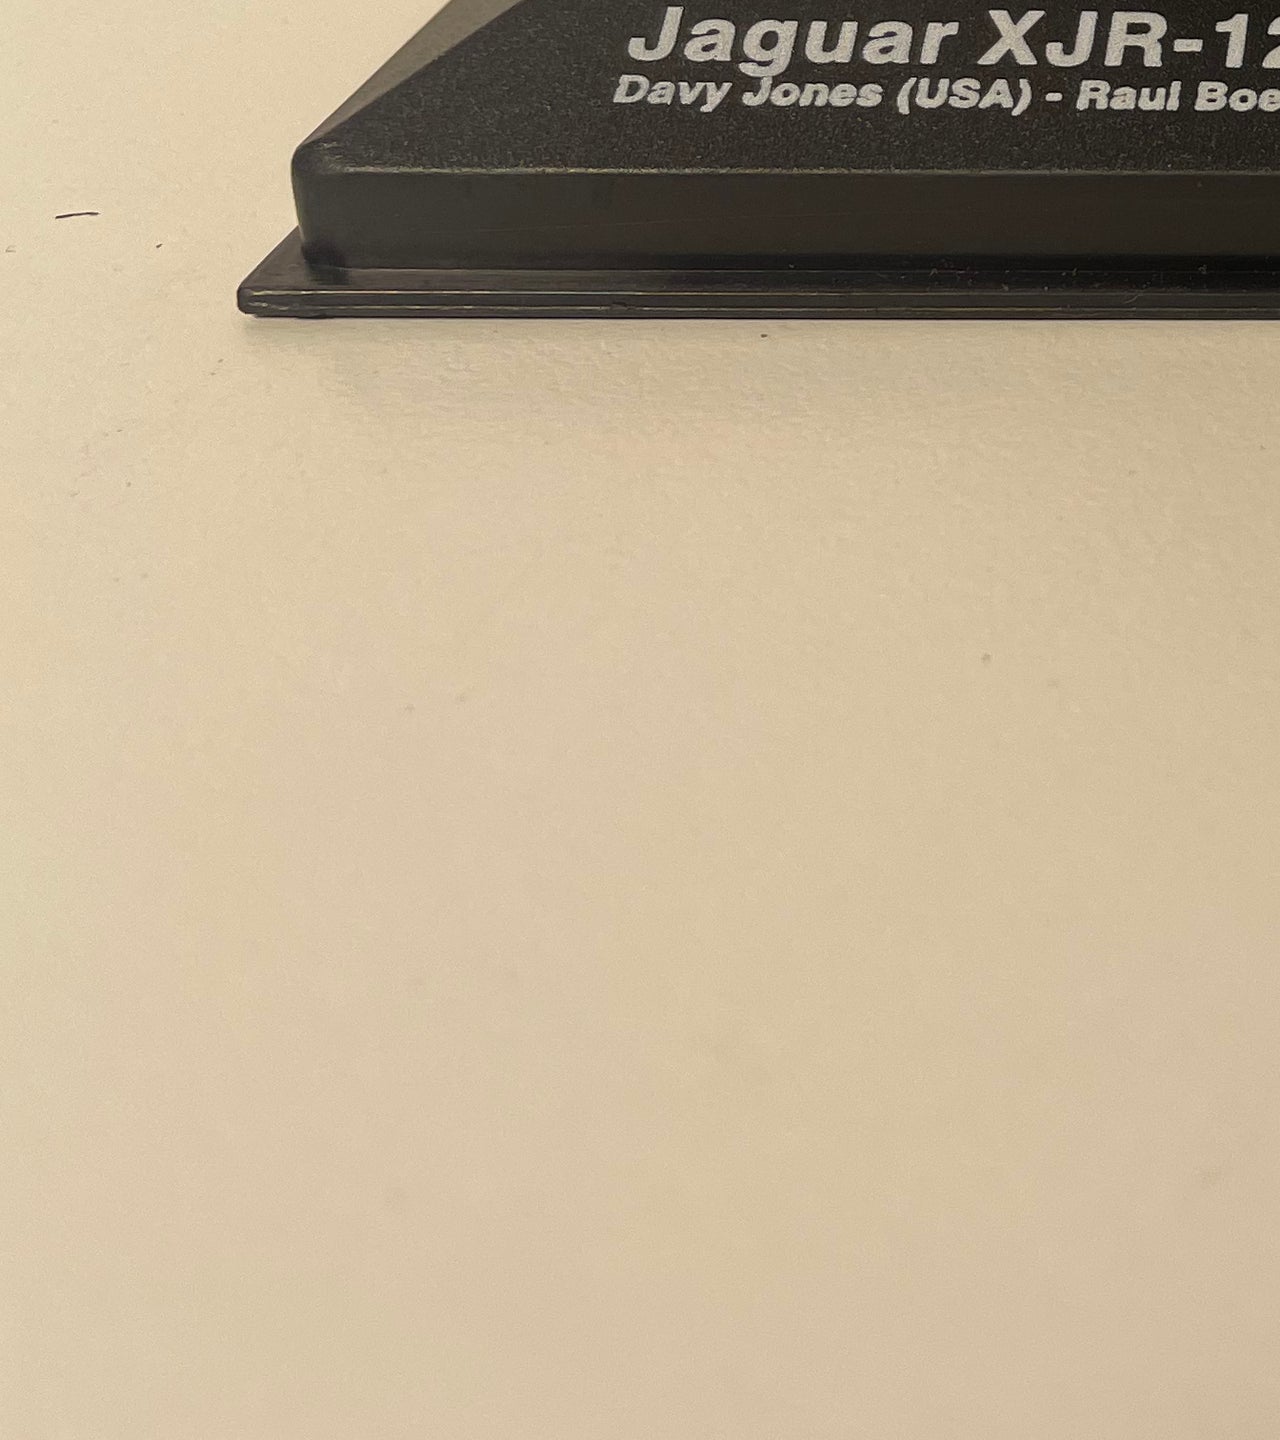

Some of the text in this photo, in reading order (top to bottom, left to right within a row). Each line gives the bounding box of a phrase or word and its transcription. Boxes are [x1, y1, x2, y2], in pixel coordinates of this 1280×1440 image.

[627, 6, 961, 77] Jaguar
[612, 74, 733, 113] Davy
[742, 75, 884, 108] Jones
[896, 77, 1032, 117] (USA)
[1075, 79, 1182, 112] Raul
